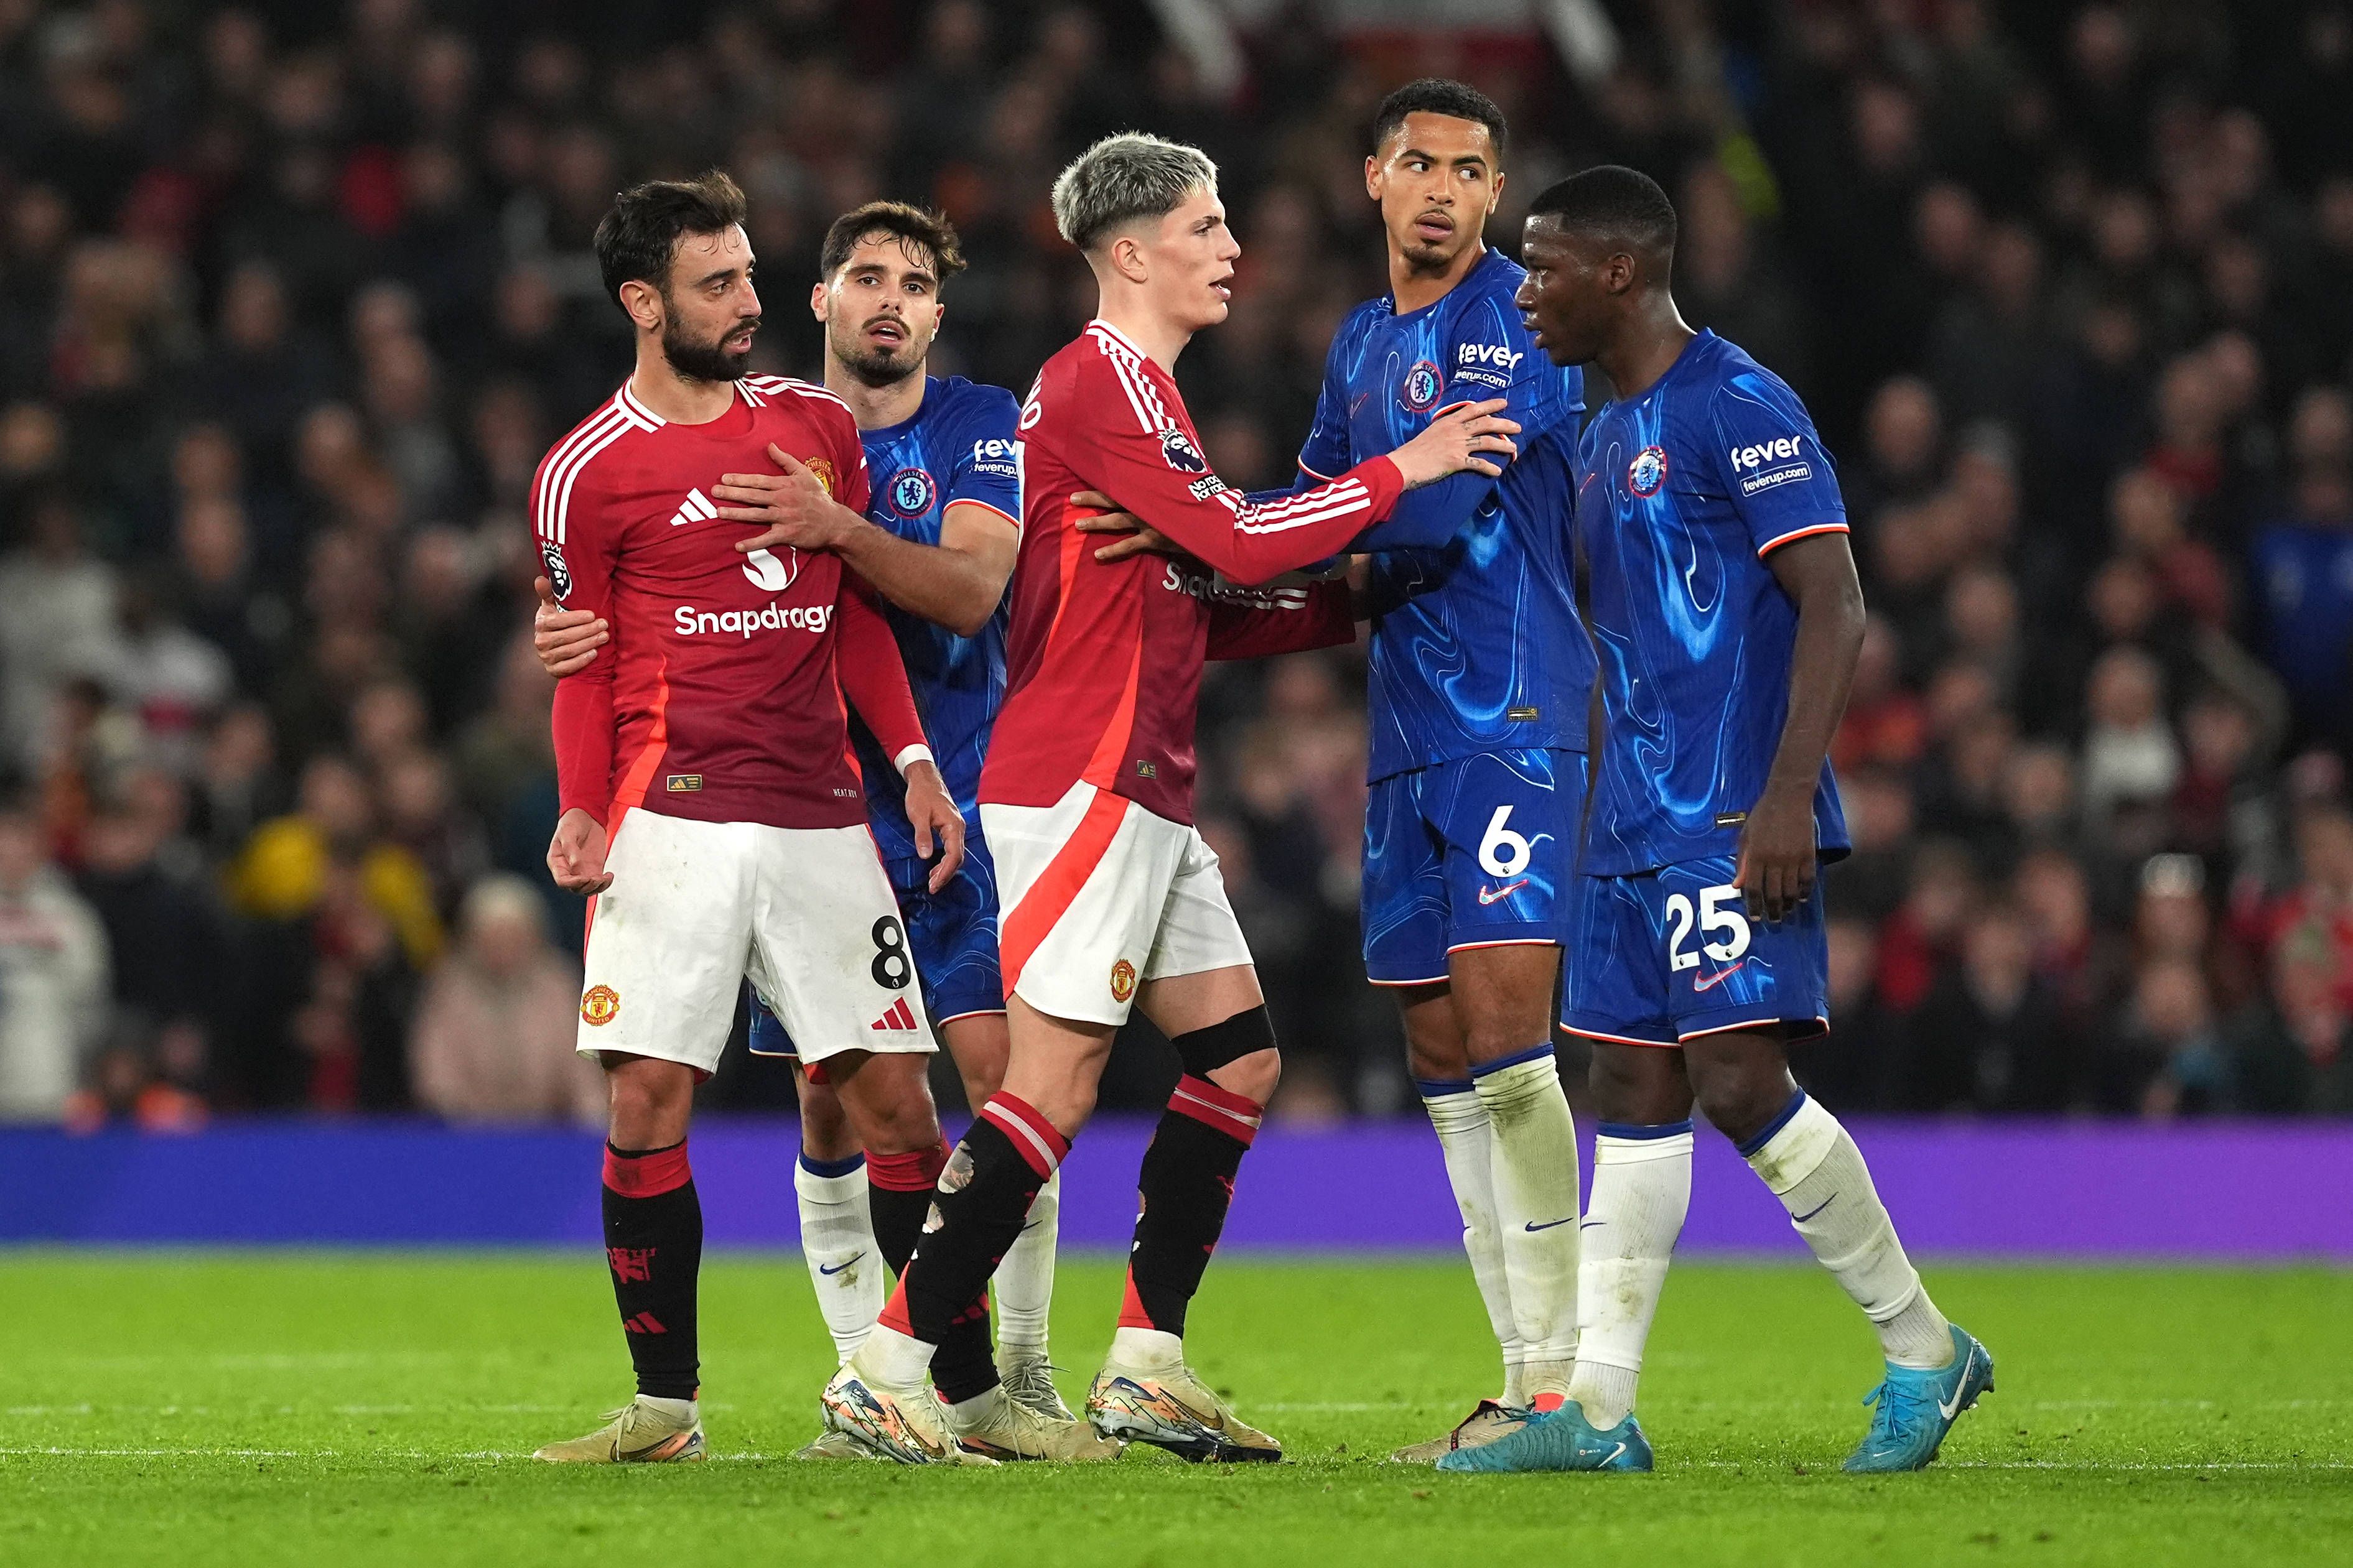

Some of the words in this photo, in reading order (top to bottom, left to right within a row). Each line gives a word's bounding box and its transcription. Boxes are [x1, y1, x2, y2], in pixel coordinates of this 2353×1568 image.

[1458, 343, 1524, 369] fever
[1731, 435, 1801, 473] fever
[1743, 467, 1809, 492] feverup.com
[1478, 805, 1531, 878] 6
[871, 915, 911, 990] 8
[1666, 884, 1751, 972] 25
